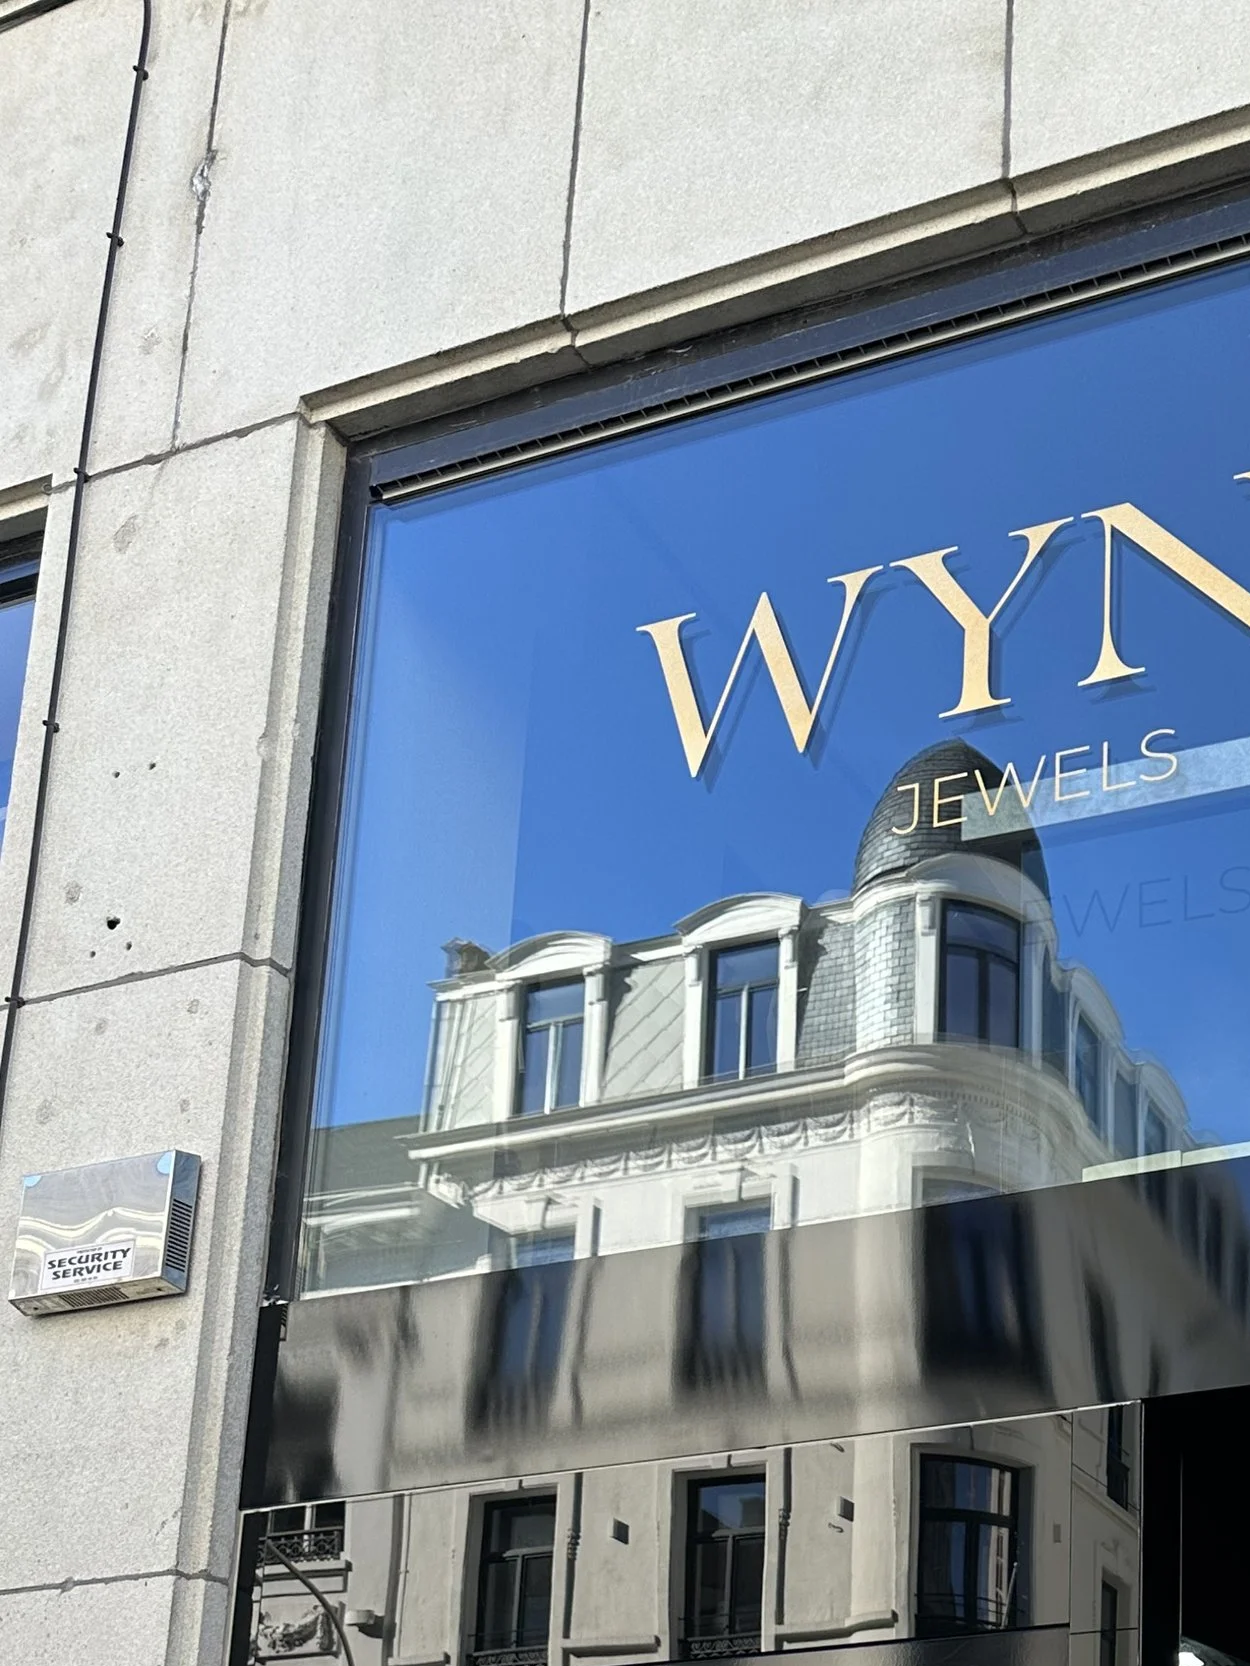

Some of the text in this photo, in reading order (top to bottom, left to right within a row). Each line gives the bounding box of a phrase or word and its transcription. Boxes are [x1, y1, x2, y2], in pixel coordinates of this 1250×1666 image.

[891, 729, 1178, 834] JEWELS
[47, 1248, 131, 1269] SECURITY
[52, 1261, 123, 1280] SERVICE
